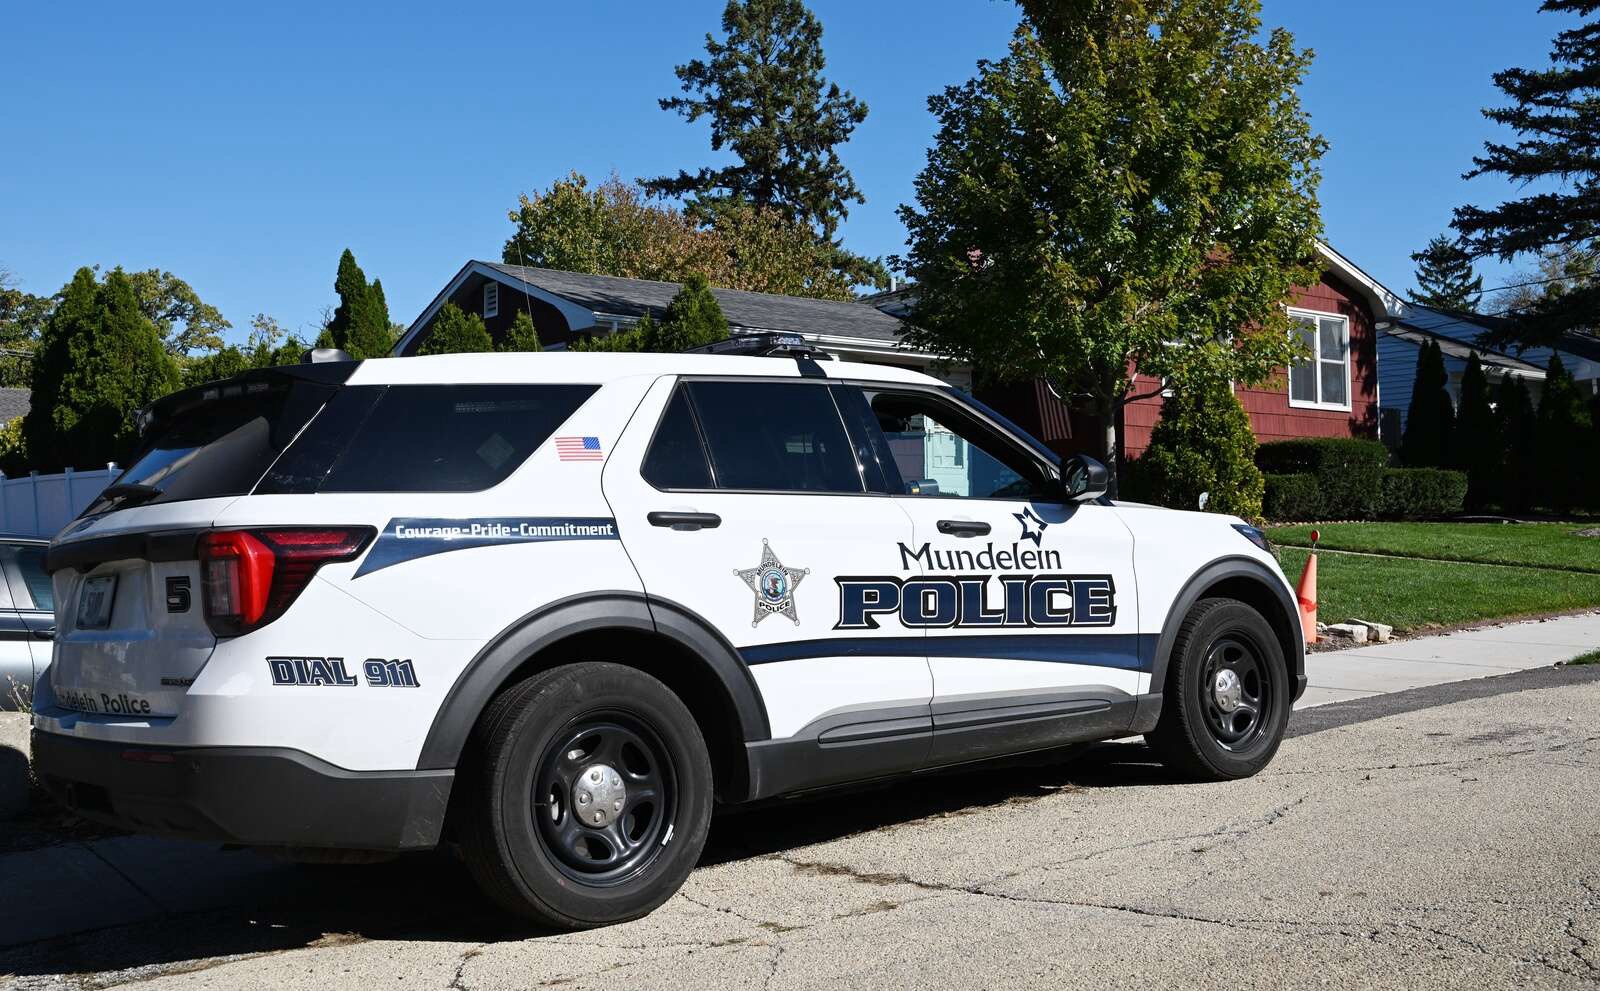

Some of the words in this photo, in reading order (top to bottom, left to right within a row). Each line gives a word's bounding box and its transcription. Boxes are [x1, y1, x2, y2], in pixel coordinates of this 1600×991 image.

[756, 561, 788, 576] MUNDELEIN
[897, 542, 1062, 570] Mundelein
[165, 576, 191, 613] 5
[759, 600, 790, 612] POLICE
[831, 574, 1117, 630] POLICE
[266, 656, 357, 687] DIAL
[363, 657, 421, 688] 911
[101, 694, 150, 714] Police
